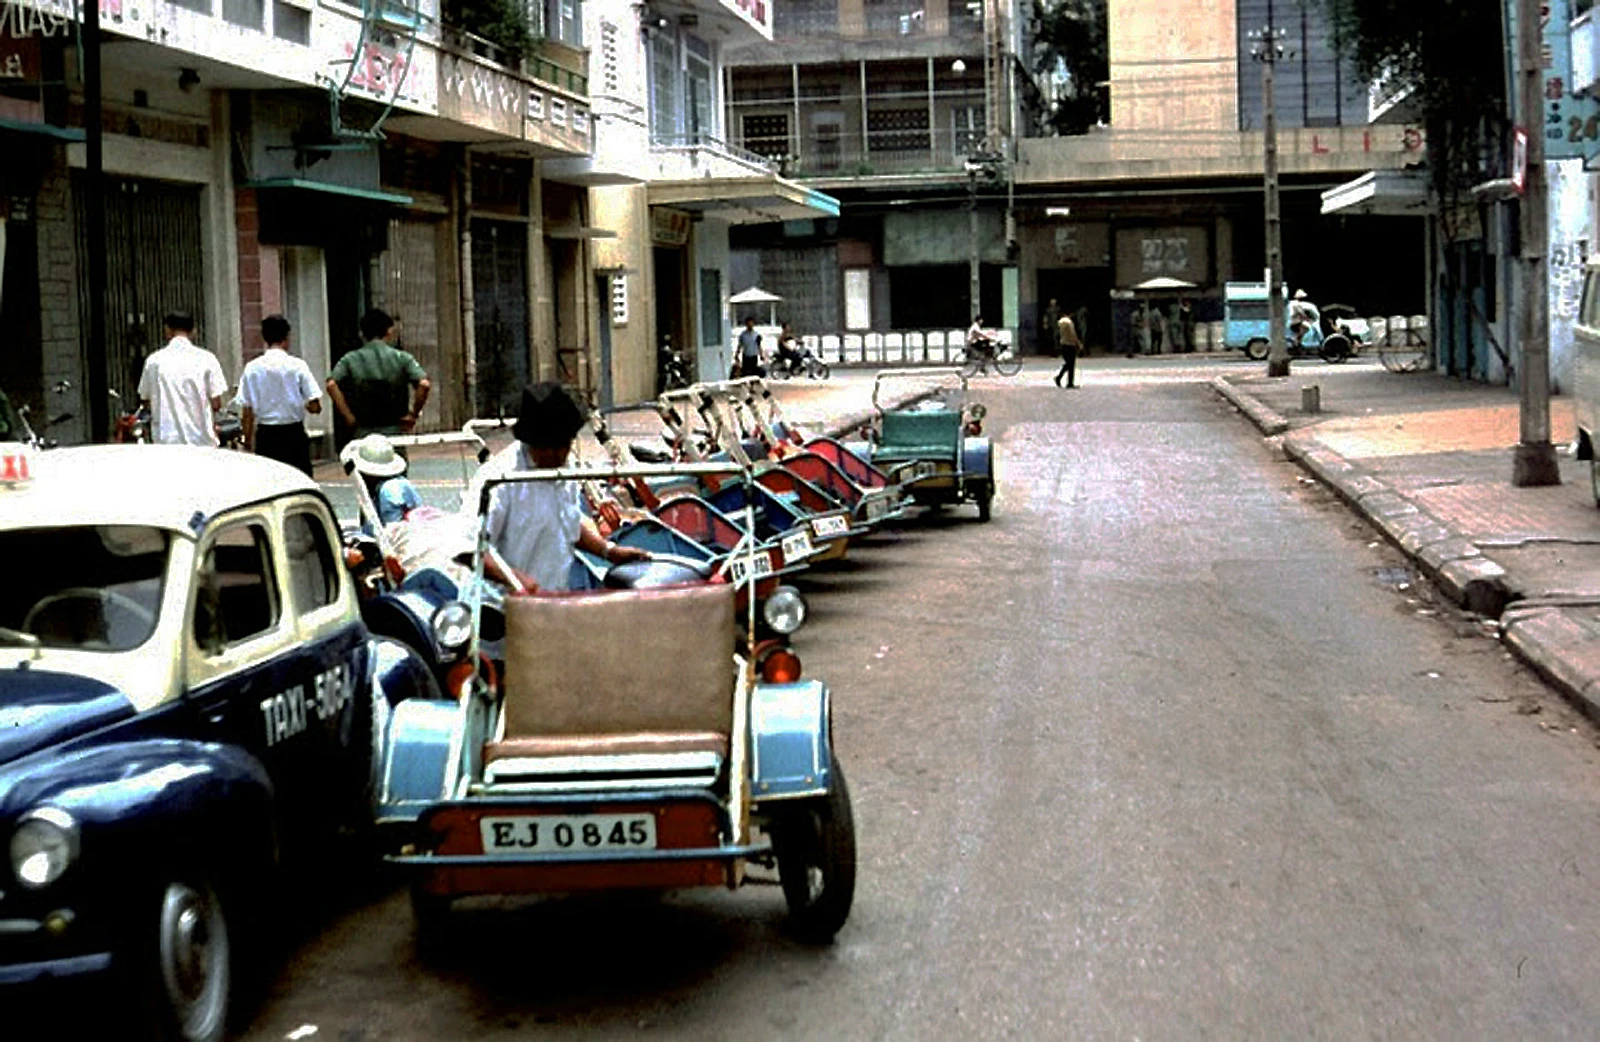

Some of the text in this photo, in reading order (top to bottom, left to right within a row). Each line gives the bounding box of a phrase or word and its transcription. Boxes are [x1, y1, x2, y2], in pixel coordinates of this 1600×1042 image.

[0, 454, 29, 480] XI
[491, 820, 648, 848] EJ 0845
